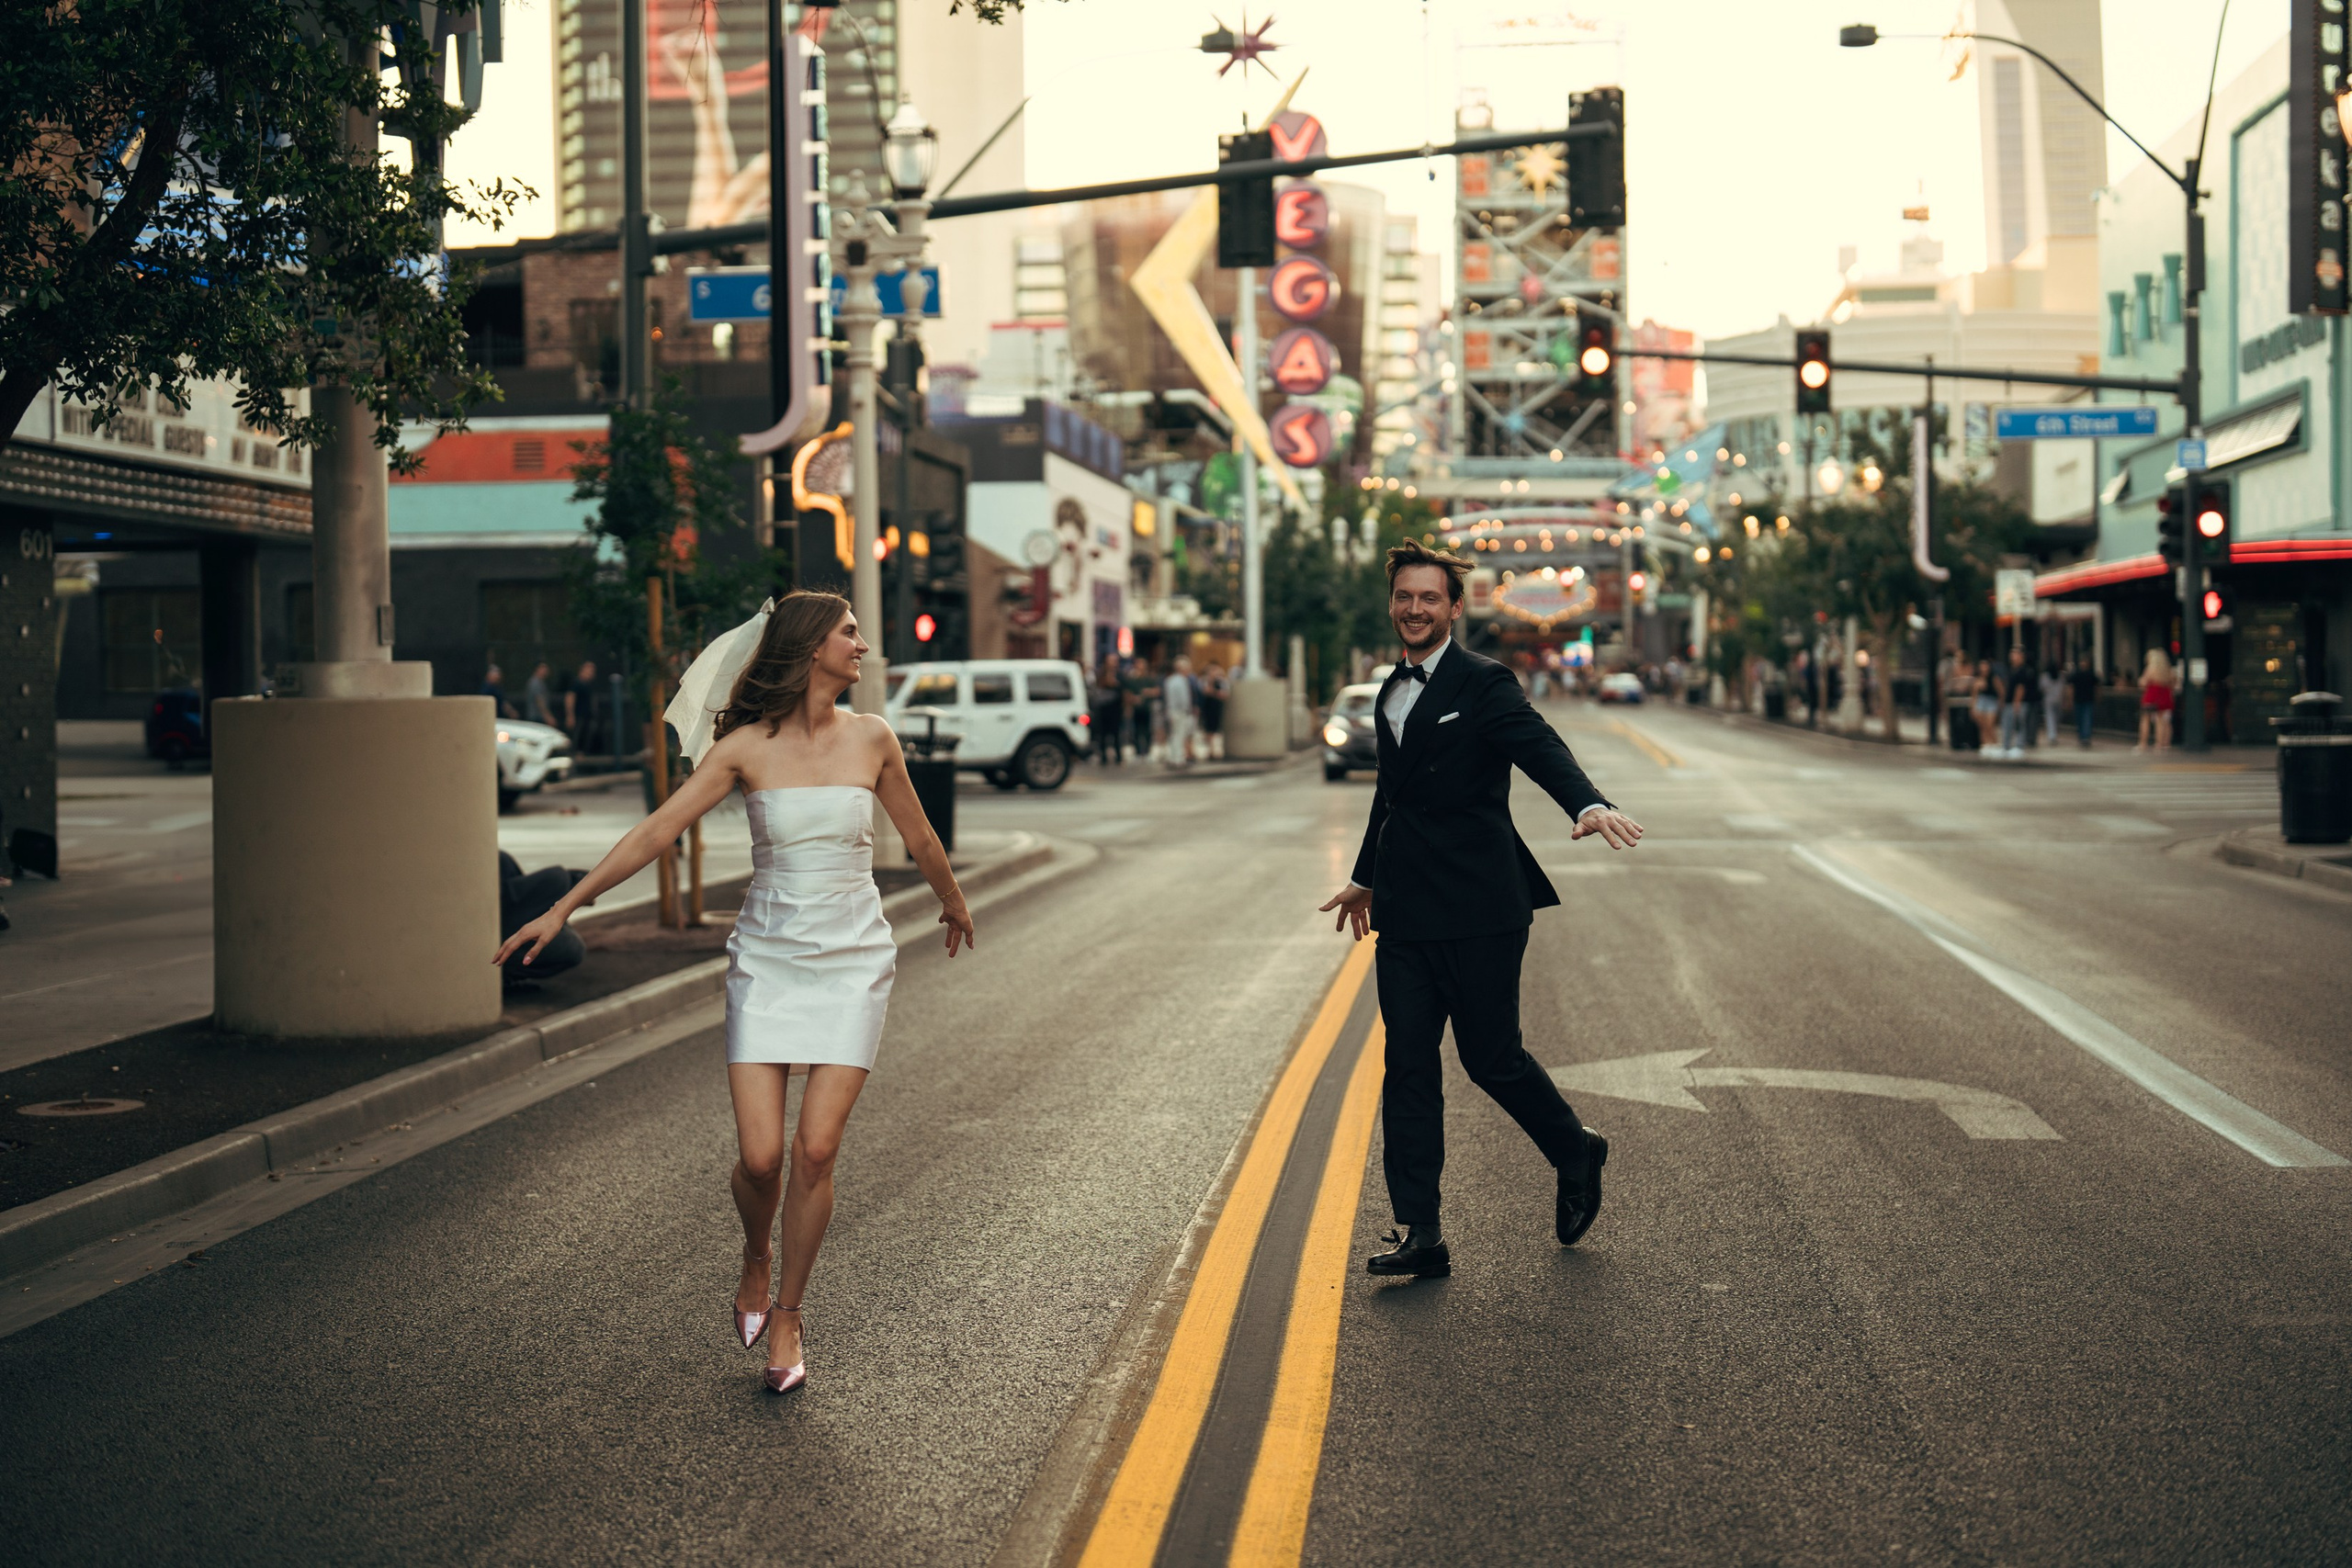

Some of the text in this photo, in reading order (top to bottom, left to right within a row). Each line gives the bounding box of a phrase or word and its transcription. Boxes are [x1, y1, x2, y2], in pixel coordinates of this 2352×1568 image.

[1270, 115, 1329, 465] VEGAS
[2035, 414, 2066, 435] 6th
[2069, 414, 2120, 435] Street
[19, 527, 53, 559] 601
